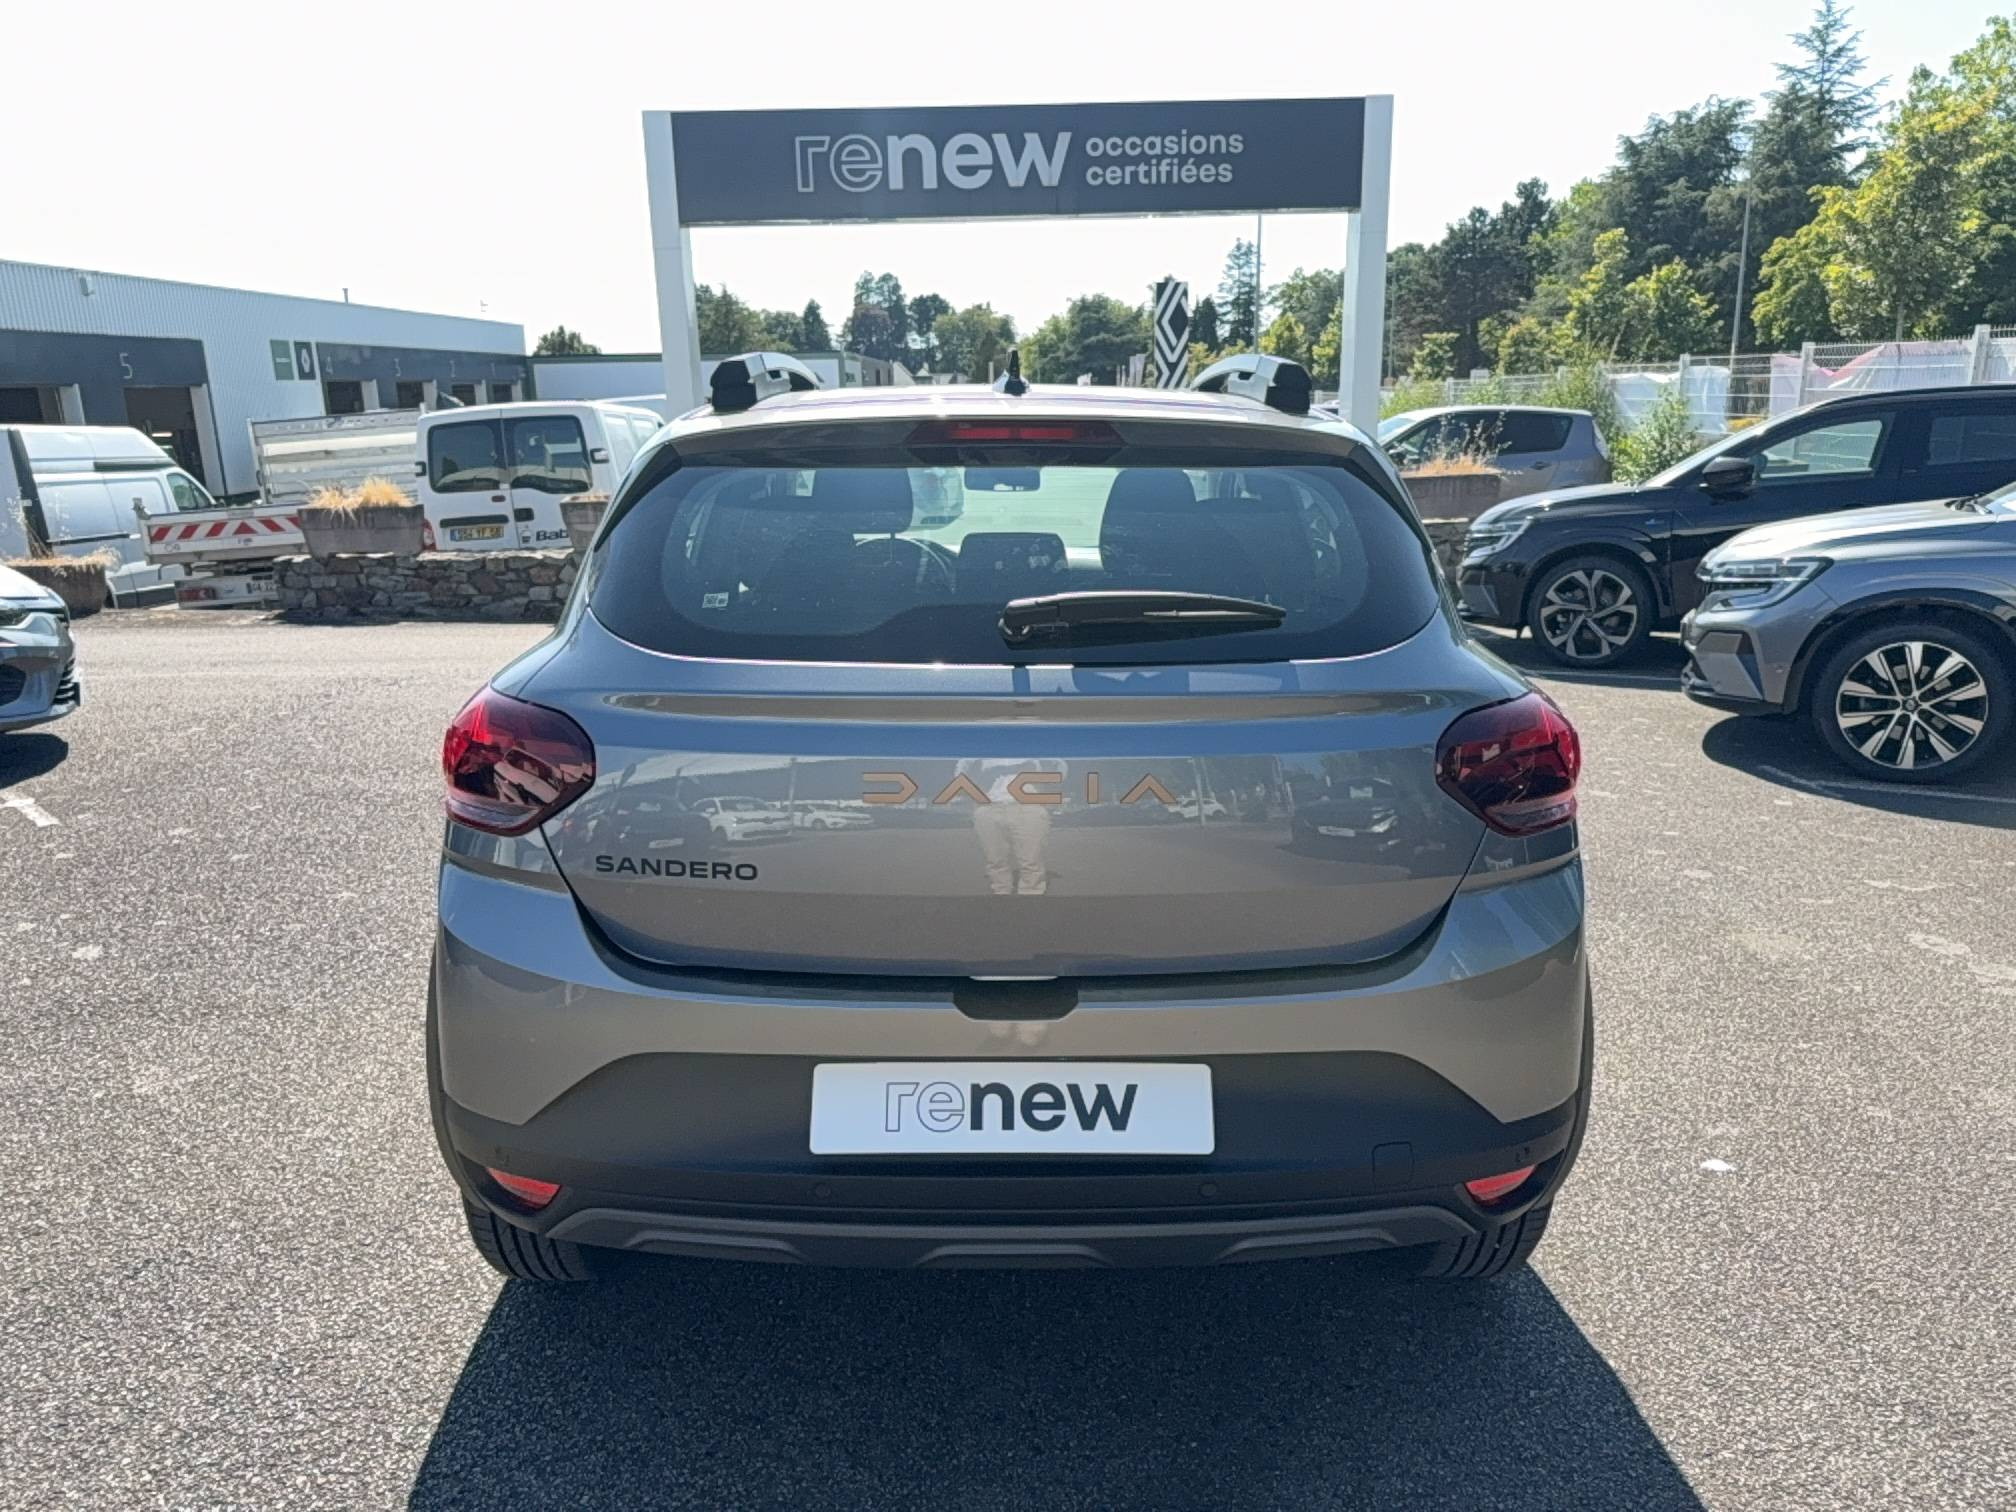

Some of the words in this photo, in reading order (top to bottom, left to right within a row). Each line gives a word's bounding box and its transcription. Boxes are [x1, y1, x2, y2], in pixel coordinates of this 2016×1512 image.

[1086, 129, 1244, 156] occasions
[795, 131, 1072, 192] renew
[1085, 158, 1233, 186] certifiées
[119, 352, 133, 380] 5
[862, 771, 1178, 804] DACIA
[595, 855, 758, 882] SANDERO
[885, 1081, 1138, 1133] renew
